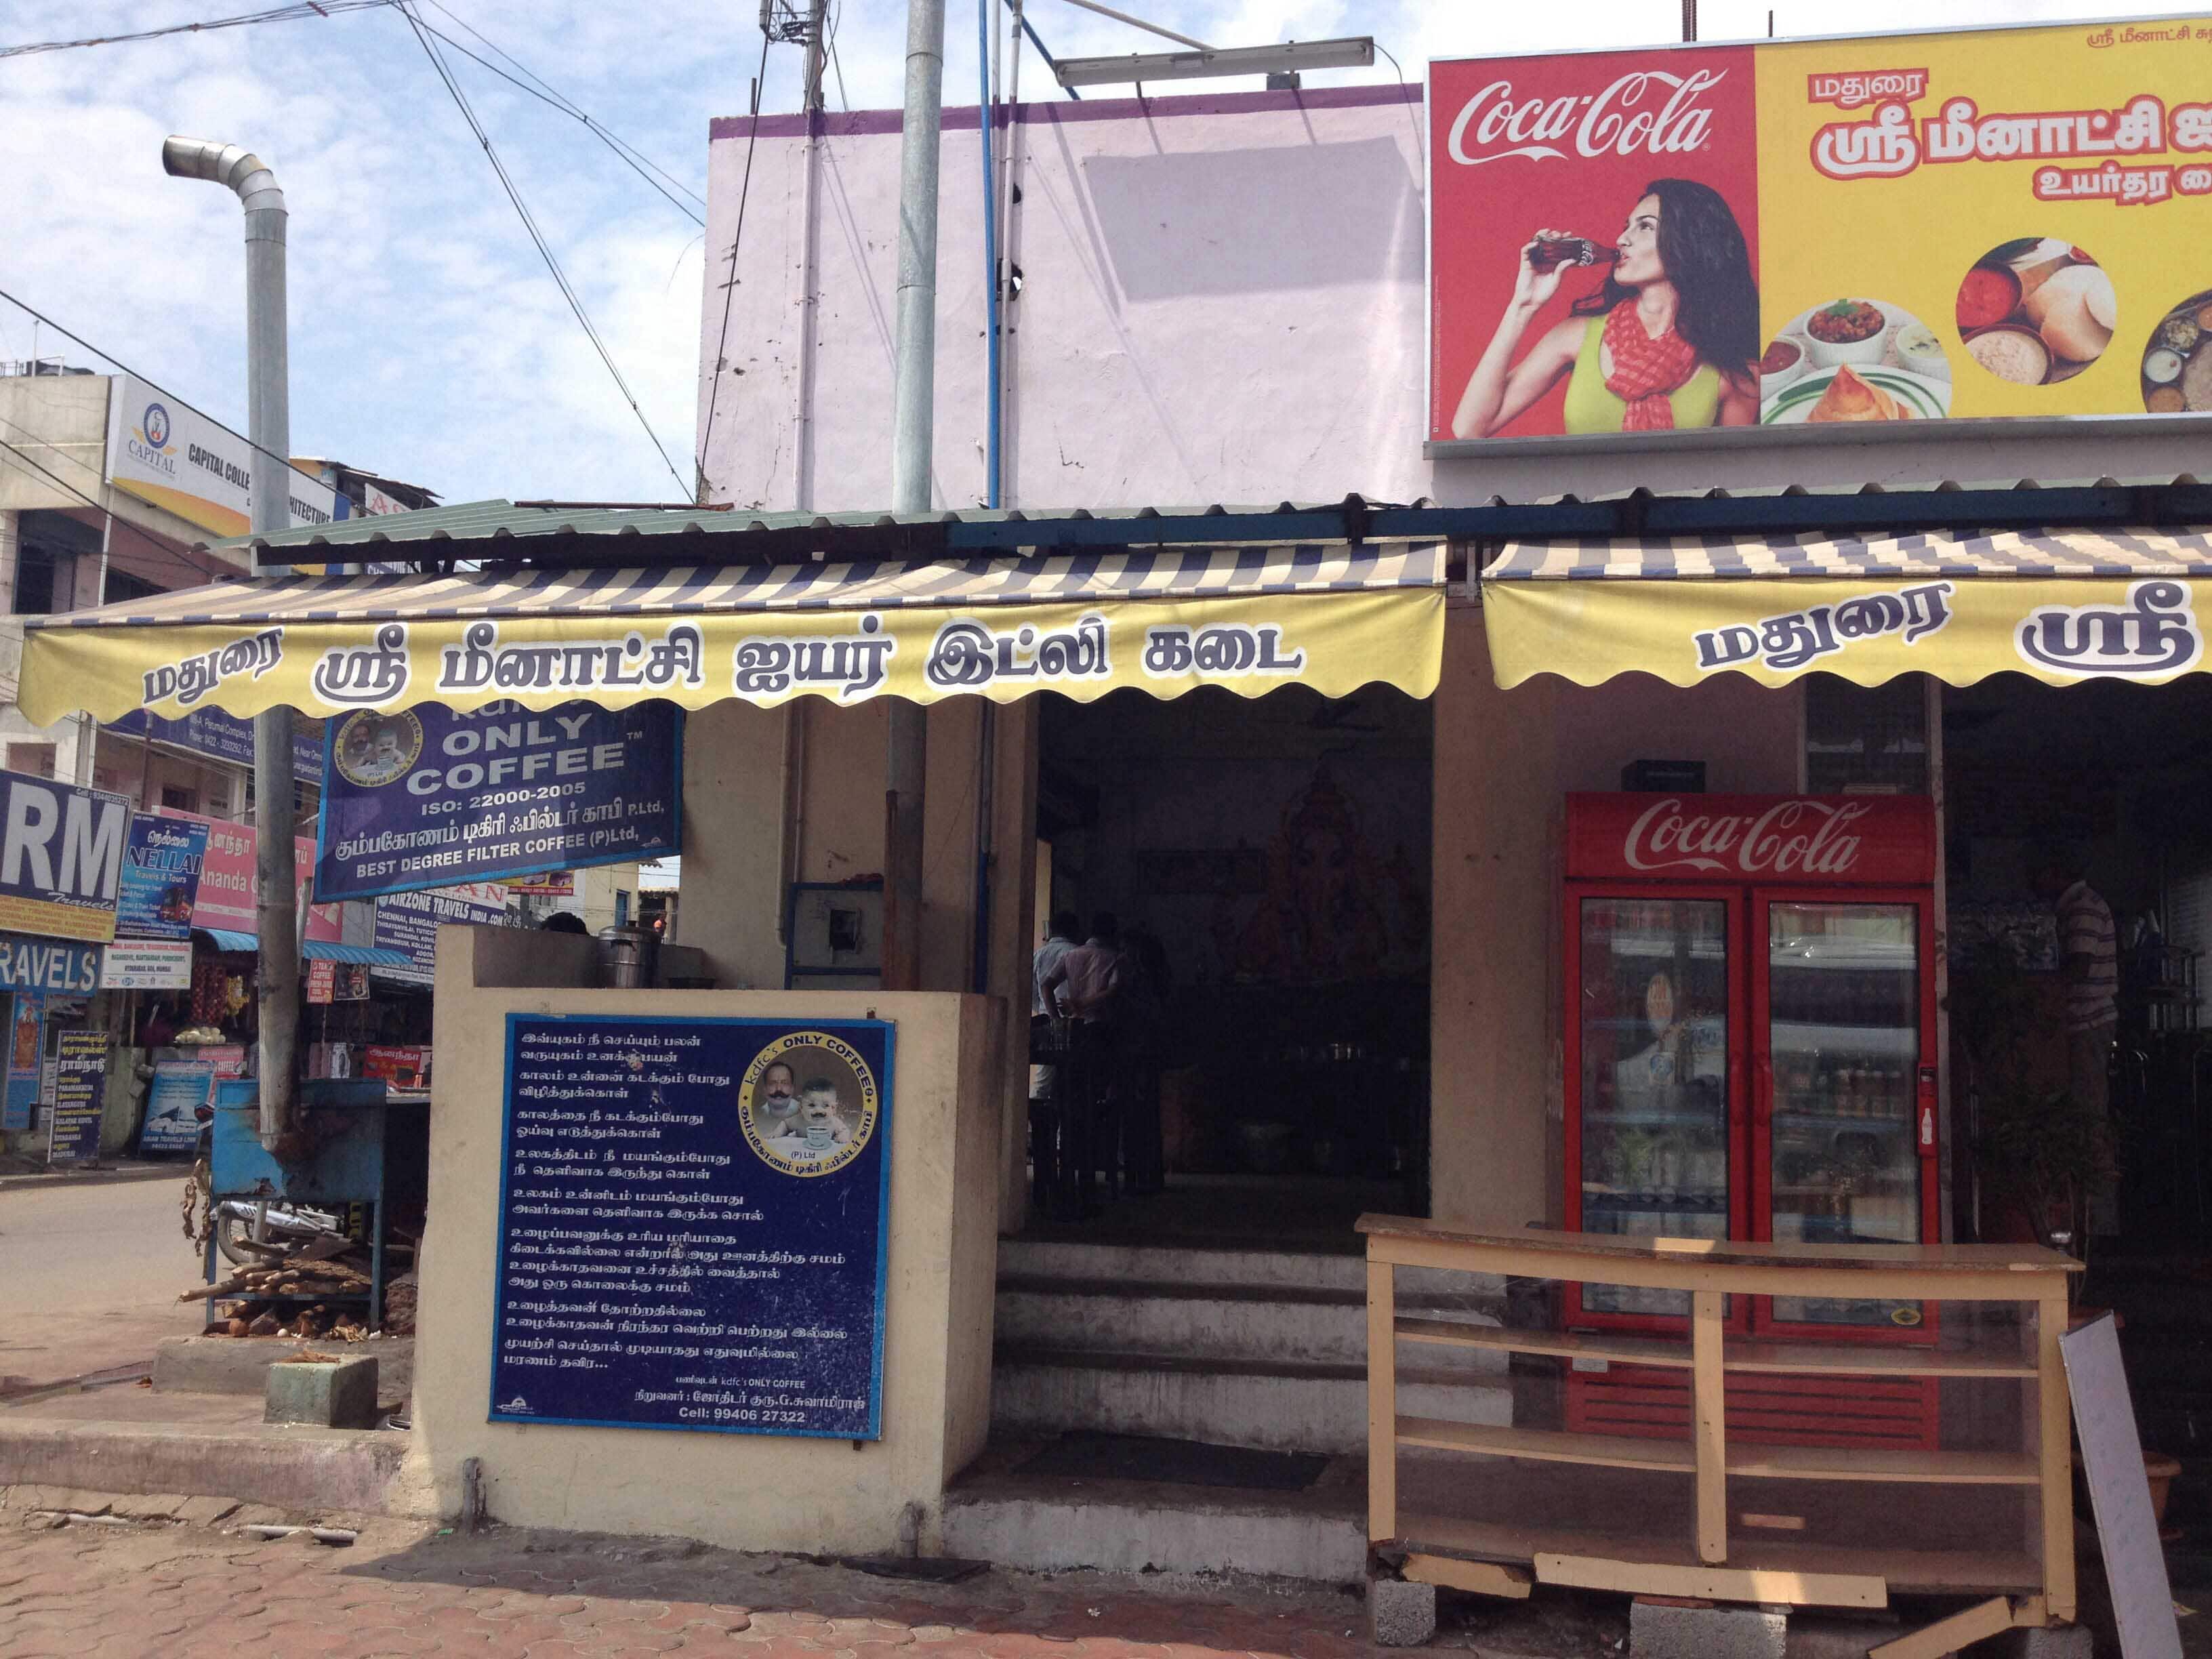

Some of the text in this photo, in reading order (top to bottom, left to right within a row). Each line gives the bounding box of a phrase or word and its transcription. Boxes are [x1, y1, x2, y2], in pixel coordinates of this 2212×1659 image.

[2119, 25, 2190, 44] மீனாட்சி
[1814, 73, 1923, 105] மதுரை
[1448, 67, 1730, 166] Coca-Cola
[1929, 102, 2160, 159] மீனாட்சி
[2040, 164, 2169, 200] உயர்தர
[128, 438, 176, 475] CAPITAL
[188, 443, 224, 478] CAPITAL
[1694, 581, 1953, 670] மதுரை
[144, 626, 283, 705] மதுரை
[438, 621, 703, 688] மீனாட்சி
[735, 614, 893, 696] ஐயர்
[929, 616, 1111, 687] இட்லி
[1145, 627, 1303, 673] கடை
[442, 712, 592, 757] ONLY
[407, 742, 625, 796] COFFEE
[421, 781, 586, 816] ISO: 22000-2005
[335, 819, 459, 861] கும்பகோணம்
[463, 814, 506, 844] டிகிரி
[509, 802, 579, 834] ஃபில்டர்
[581, 796, 623, 823] காபி
[1624, 798, 1875, 874] Coca-Cola
[1, 780, 127, 900] RM
[147, 829, 190, 848] நெல்லை
[127, 845, 203, 876] NELLAI
[356, 861, 398, 878] BEST
[401, 851, 462, 874] DEGREE
[467, 842, 520, 862] FILTER
[525, 834, 586, 854] COFFEE
[168, 874, 187, 884] Tours
[47, 891, 115, 911] Travels
[388, 892, 432, 914] AIRZONE
[432, 897, 470, 920] TRAVELS
[470, 909, 487, 924] INDIA
[377, 910, 408, 925] CHENNAI,
[588, 1033, 600, 1046] நீ
[603, 1034, 661, 1047] செய்யும்
[663, 1035, 701, 1047] பலன்
[783, 1035, 823, 1049] ONLY
[826, 1038, 872, 1088] COFFEE
[519, 1069, 565, 1082] காலம்
[627, 1071, 684, 1084] கடக்கும்
[688, 1073, 730, 1086] போது
[516, 1109, 704, 1126] காலத்தை நீ கடக்கும்போது
[557, 1126, 661, 1140] எடுத்துக்கொள்
[514, 1147, 731, 1166] உலகத்திடம் நீ மயங்கும்போது
[513, 1163, 711, 1181] நீ தெளிவாக இருந்து கொள்
[513, 1187, 743, 1206] உலகம் உன்னிடம் மயங்கும்போது
[512, 1204, 764, 1221] அவர்களை தெளிவாக இருக்க சொல்
[627, 1231, 663, 1242] உரிய
[687, 1248, 718, 1261] அது
[808, 1252, 846, 1265] சமம்
[707, 1265, 781, 1279] வைத்தால்
[508, 1277, 539, 1289] அது
[571, 1279, 652, 1293] கொலைக்கு
[655, 1280, 691, 1293] சமம்
[558, 1339, 623, 1353] செய்தால்
[503, 1355, 557, 1368] மரணம்
[748, 1378, 771, 1388] ONLY
[772, 1379, 806, 1389] COFFEE
[678, 1407, 806, 1423] Cell: 99406 27322
